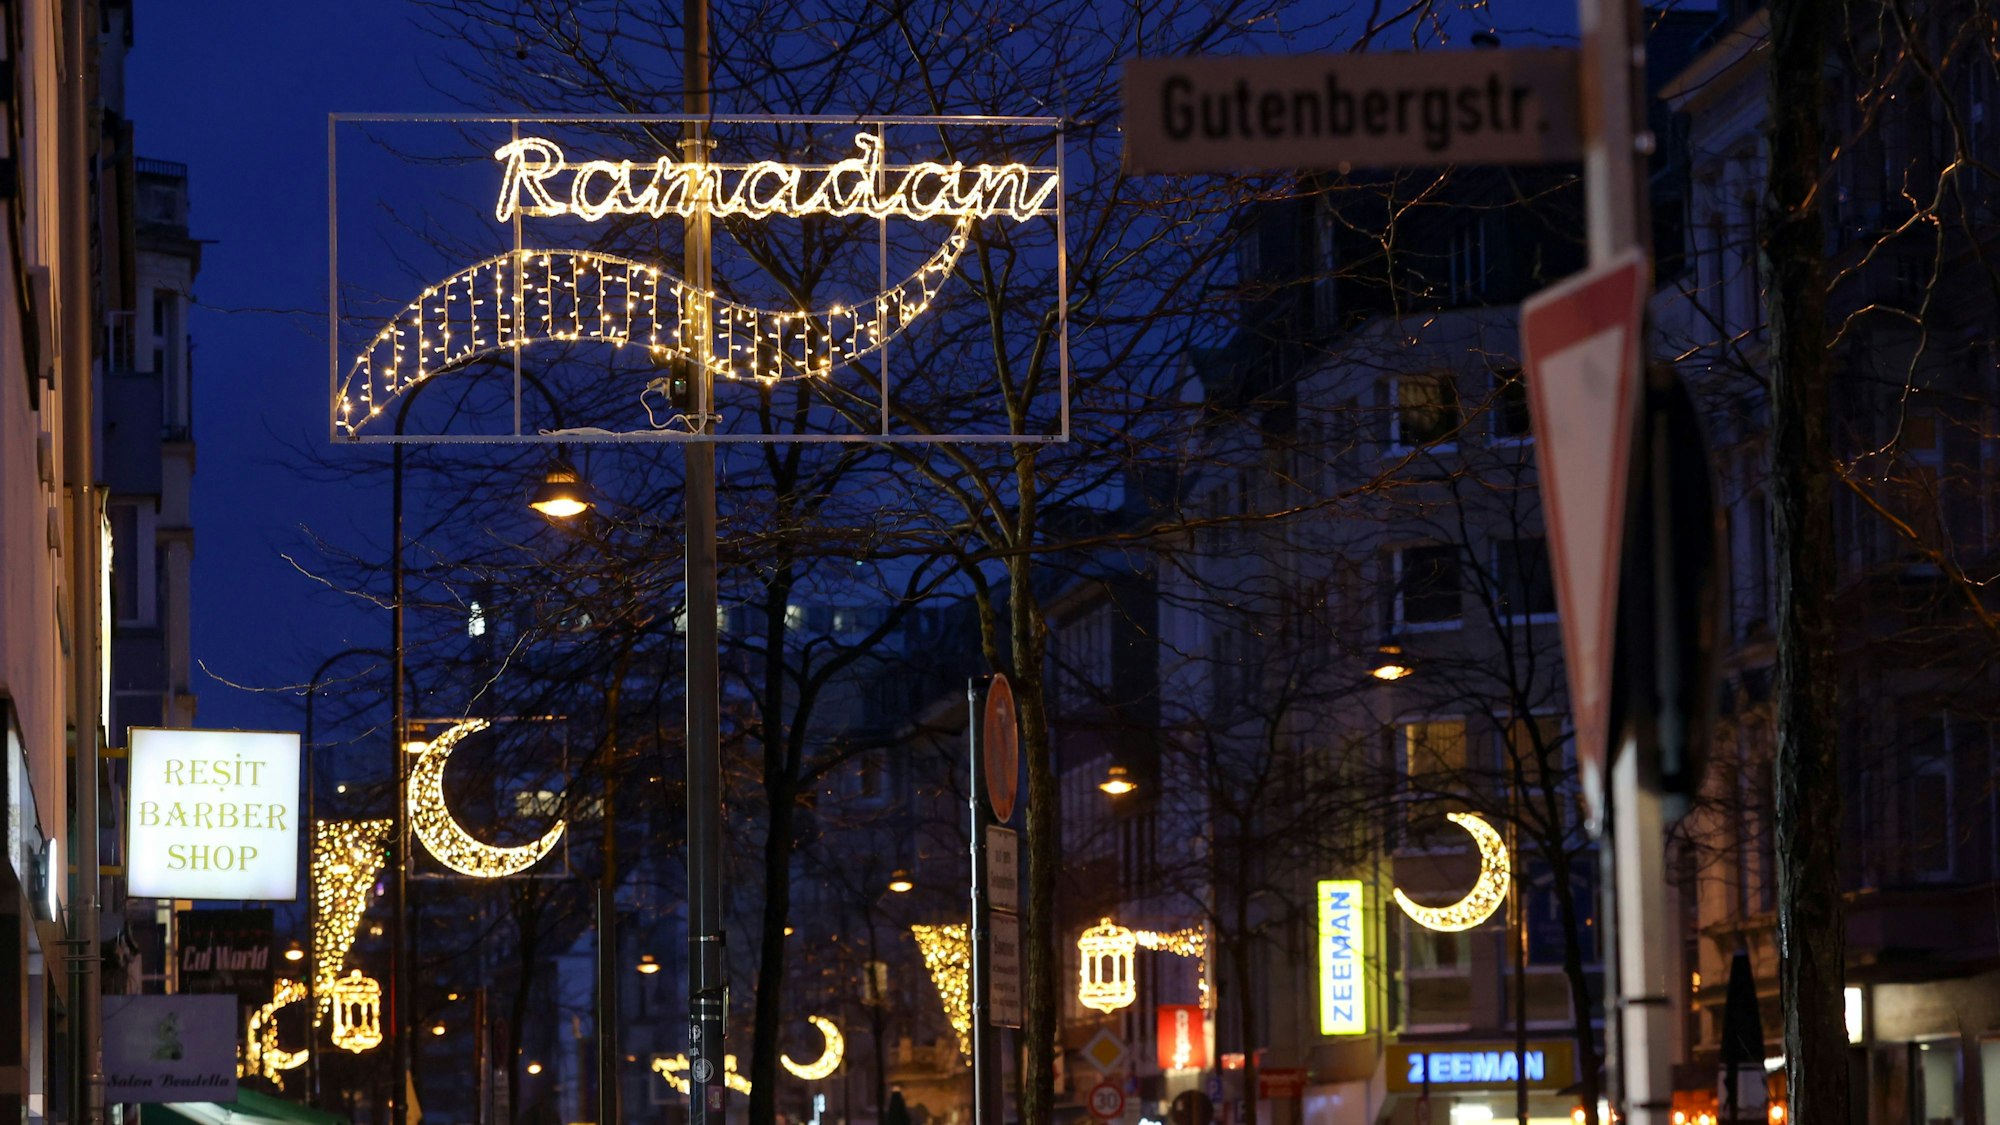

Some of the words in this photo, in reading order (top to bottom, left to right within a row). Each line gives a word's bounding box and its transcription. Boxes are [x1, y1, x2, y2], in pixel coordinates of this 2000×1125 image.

[1161, 71, 1550, 153] Gutenbergstr.
[494, 132, 1058, 223] Ramadan
[139, 801, 288, 831] BARBER
[167, 844, 258, 871] SHOP
[183, 945, 213, 971] Cut
[216, 945, 269, 971] World
[1330, 891, 1353, 1022] ZEEMAN
[107, 1073, 153, 1087] Salon
[1407, 1050, 1545, 1083] ZEEMAN
[1096, 1092, 1118, 1109] 30
